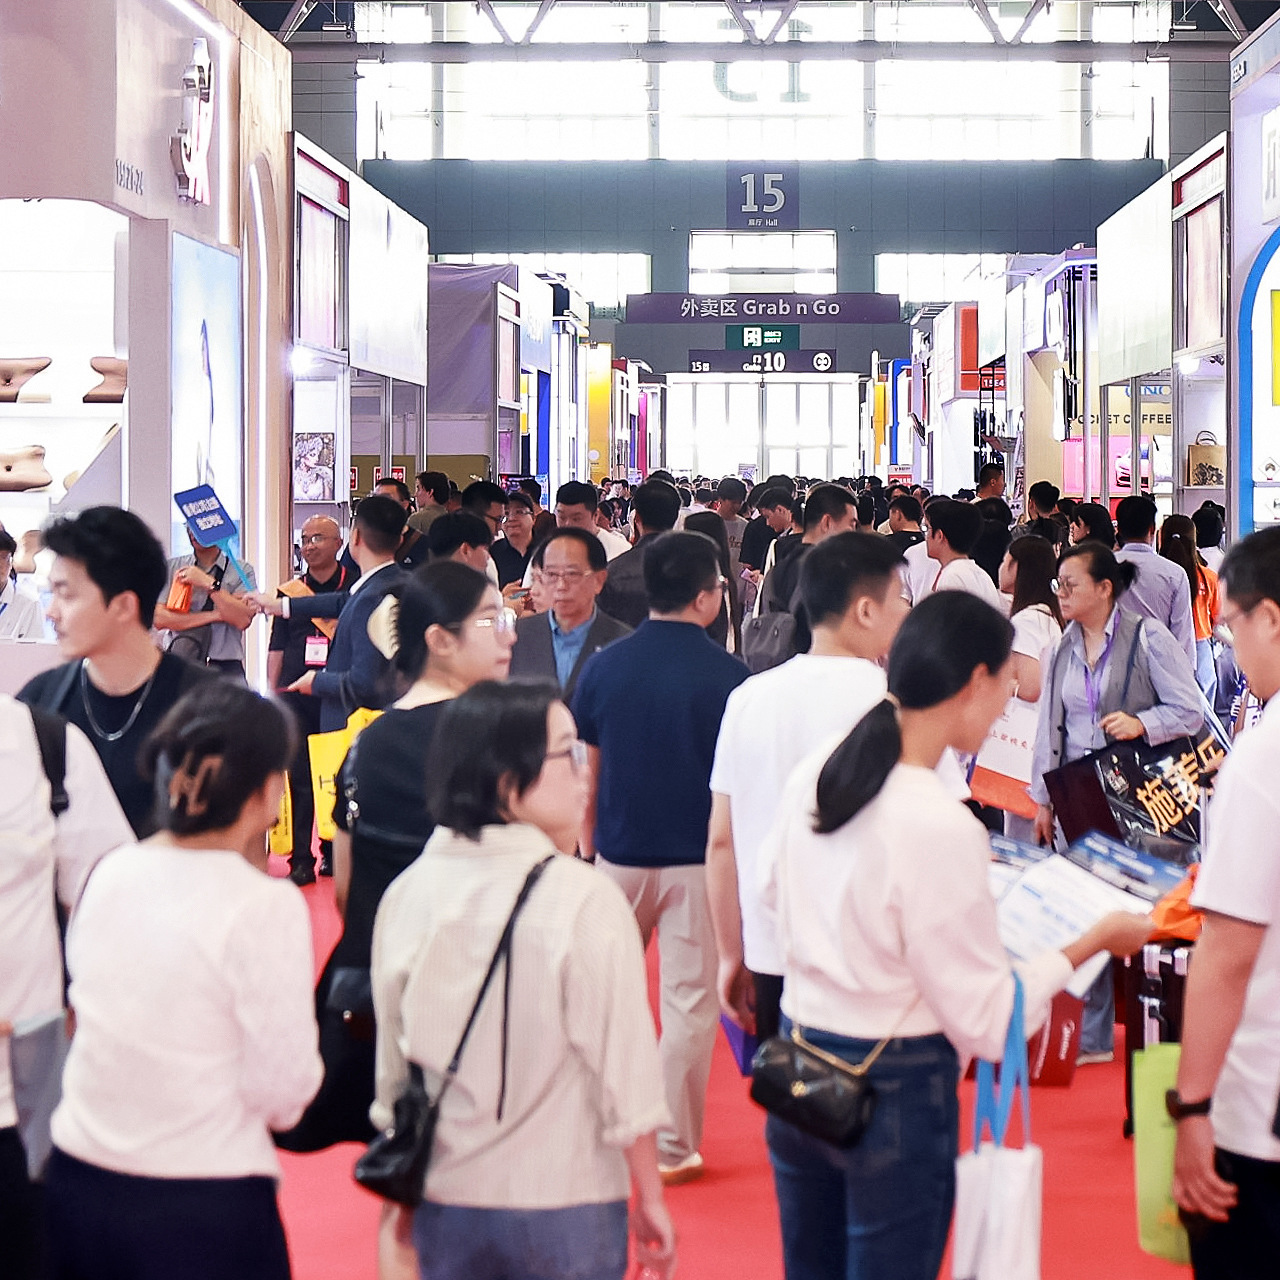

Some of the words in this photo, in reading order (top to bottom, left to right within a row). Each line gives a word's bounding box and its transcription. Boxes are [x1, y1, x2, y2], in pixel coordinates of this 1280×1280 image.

[740, 173, 786, 213] 15
[681, 298, 739, 318] 外卖区
[742, 298, 791, 316] Grab
[796, 302, 808, 315] n
[812, 299, 840, 316] Go
[763, 352, 786, 372] 10
[1123, 413, 1172, 424] CFFEE
